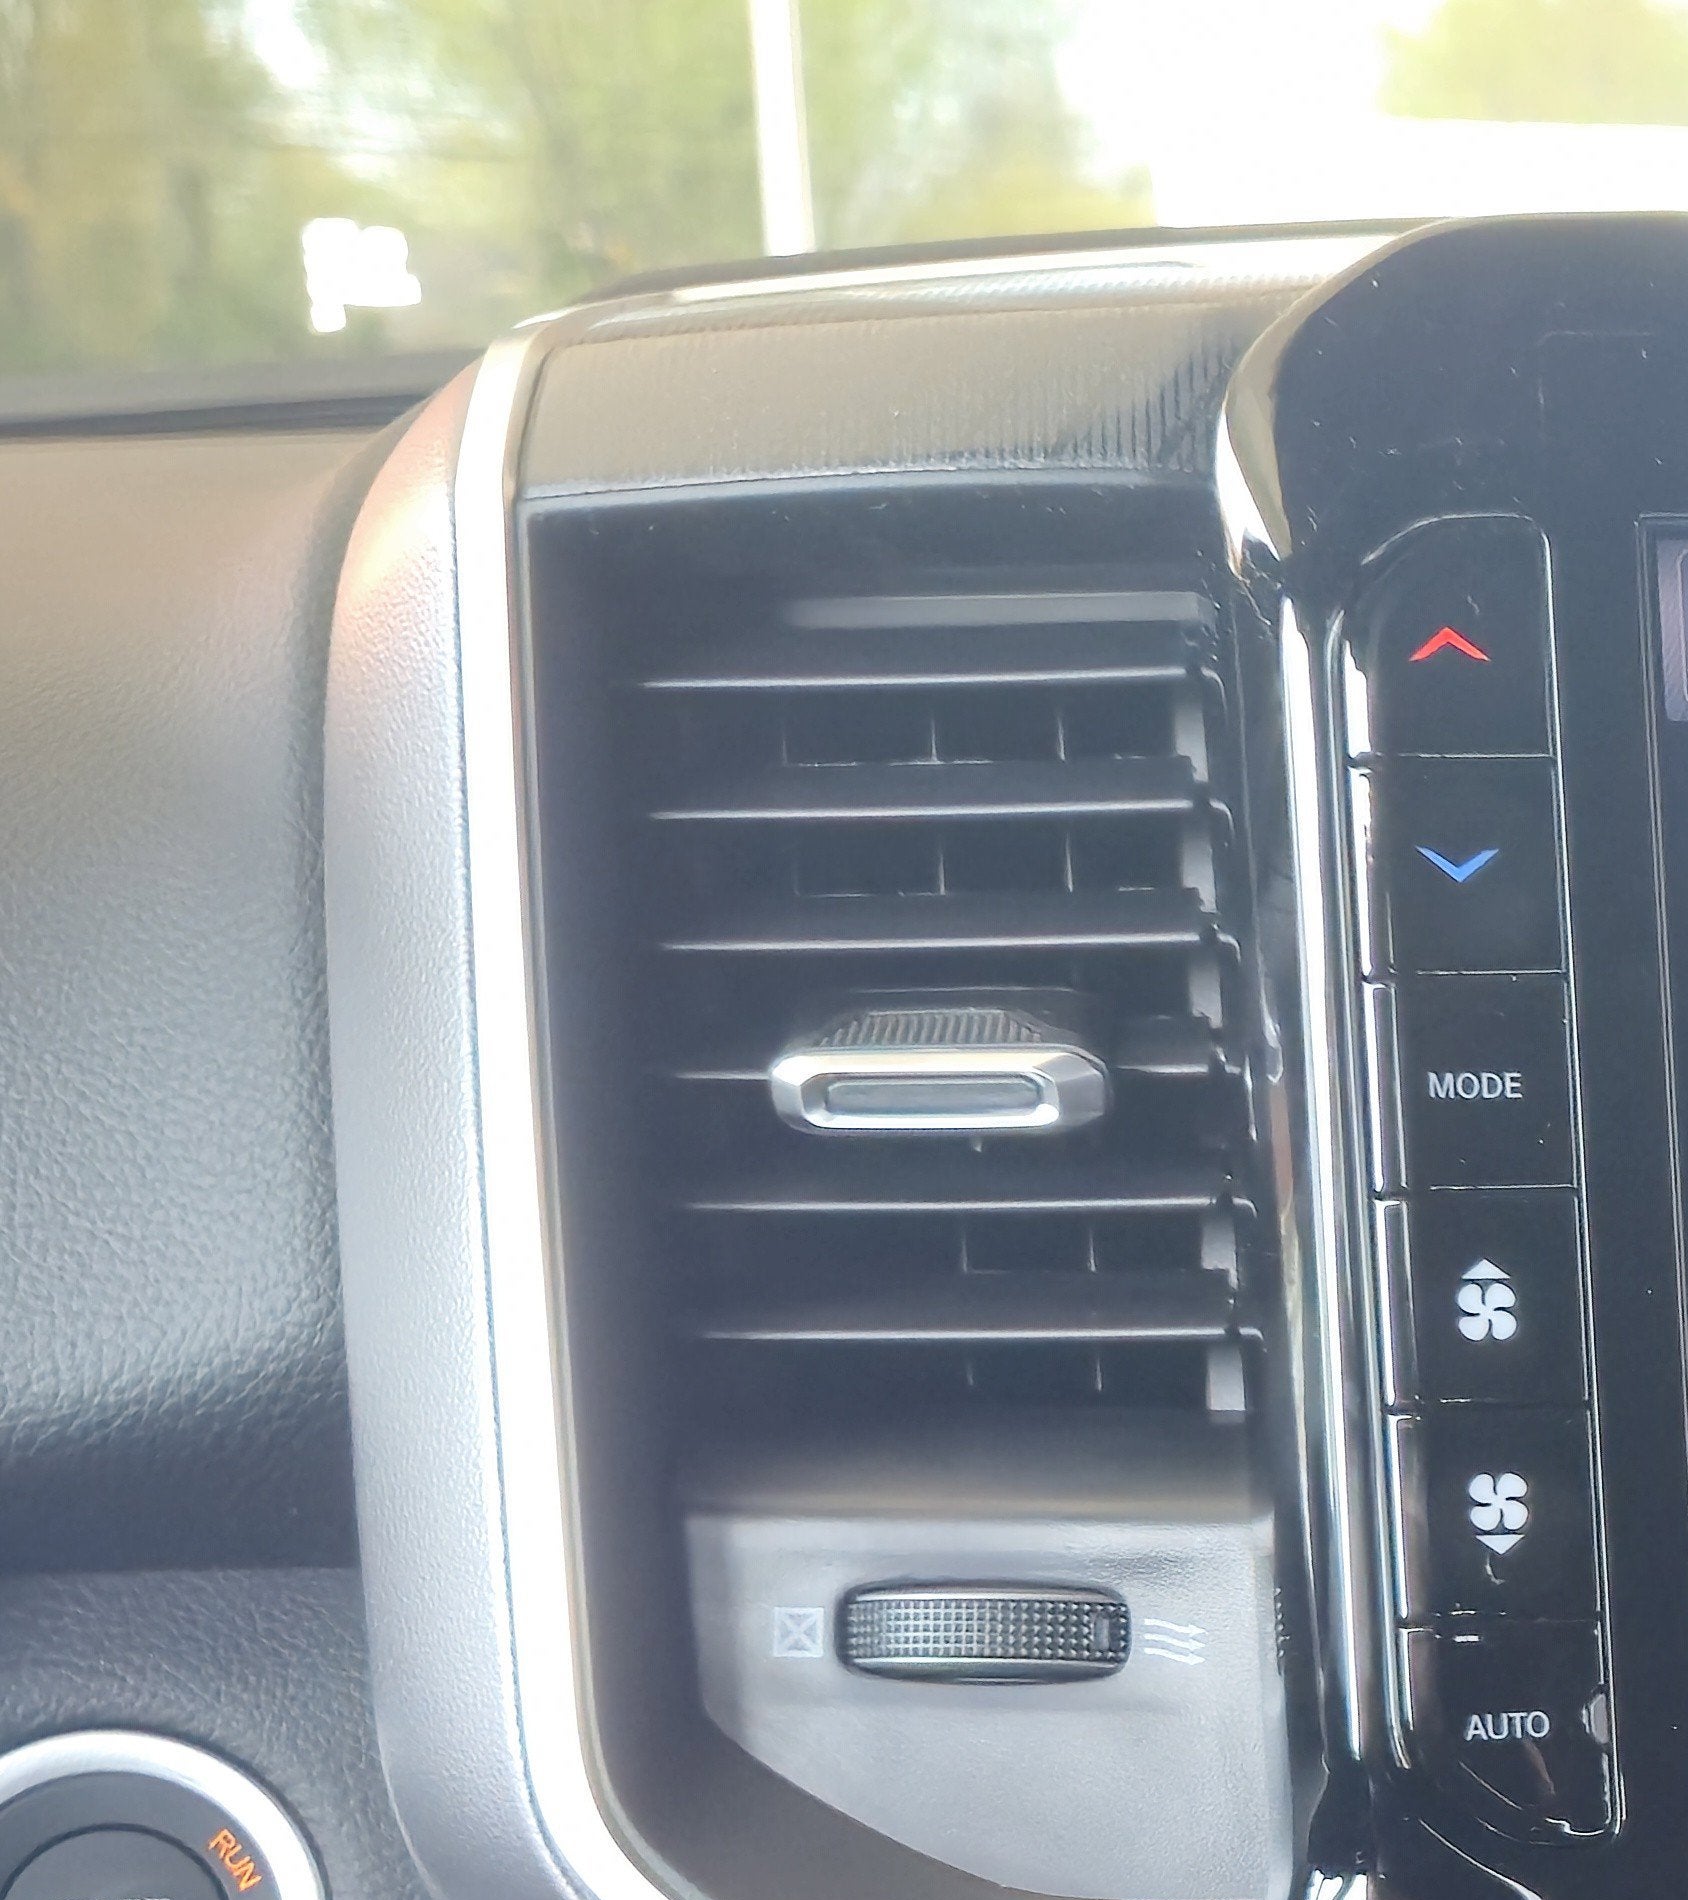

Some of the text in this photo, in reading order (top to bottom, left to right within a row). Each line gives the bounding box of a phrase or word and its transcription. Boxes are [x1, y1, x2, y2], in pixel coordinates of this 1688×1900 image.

[1428, 1071, 1523, 1101] MODE
[1465, 1711, 1551, 1741] AUTO
[207, 1828, 262, 1891] RUN
